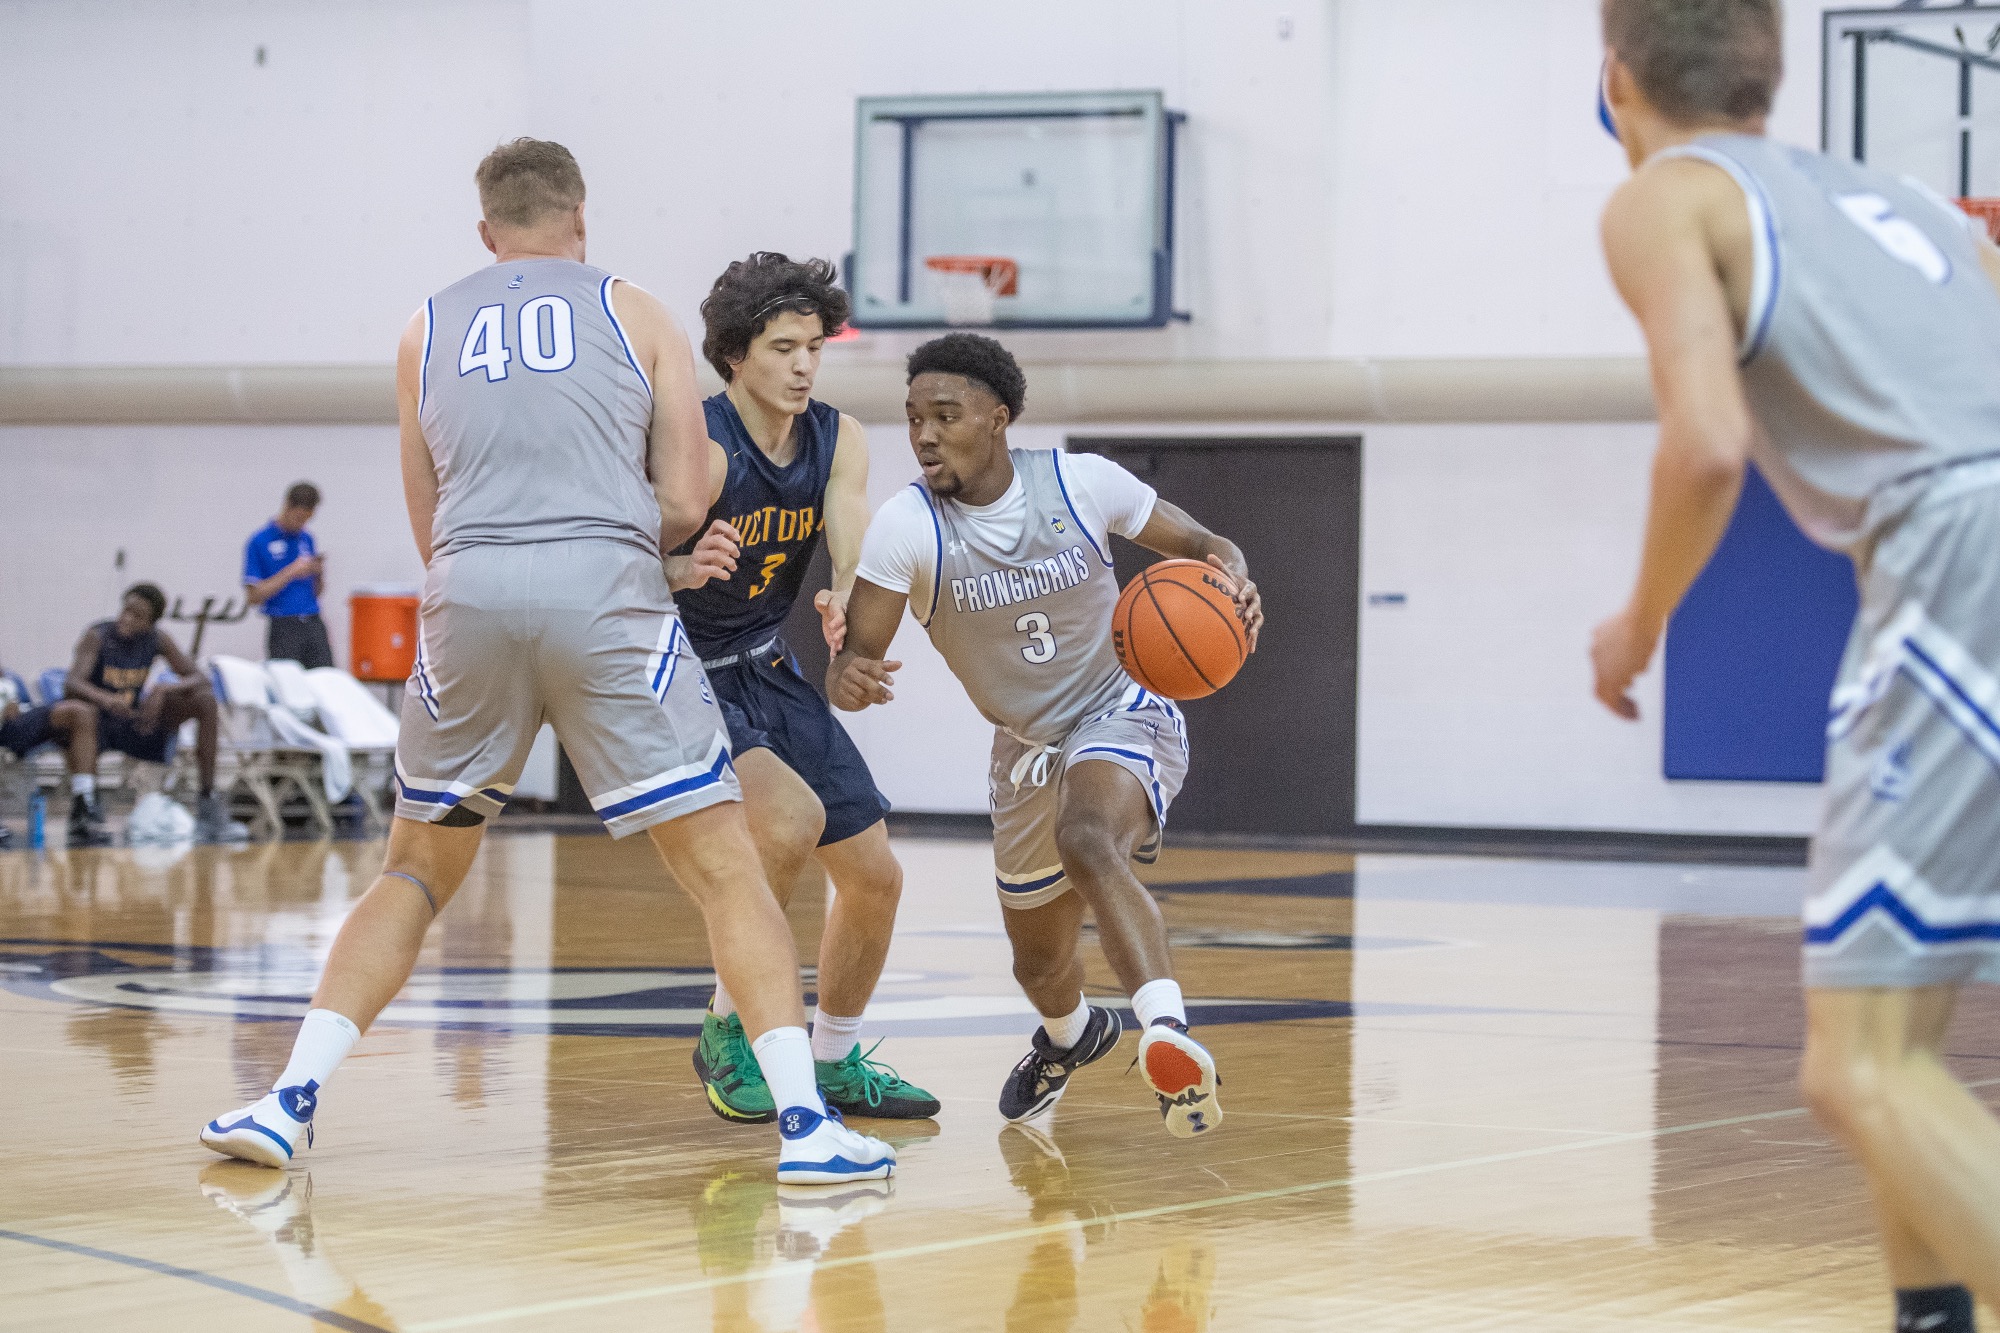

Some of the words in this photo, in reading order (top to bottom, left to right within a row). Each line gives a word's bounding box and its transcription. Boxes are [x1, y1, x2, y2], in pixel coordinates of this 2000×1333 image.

[458, 295, 576, 383] 40
[730, 507, 824, 547] ICTOR
[749, 553, 786, 599] 3
[951, 545, 1090, 613] PRONGHORNS
[1015, 611, 1057, 665] 3
